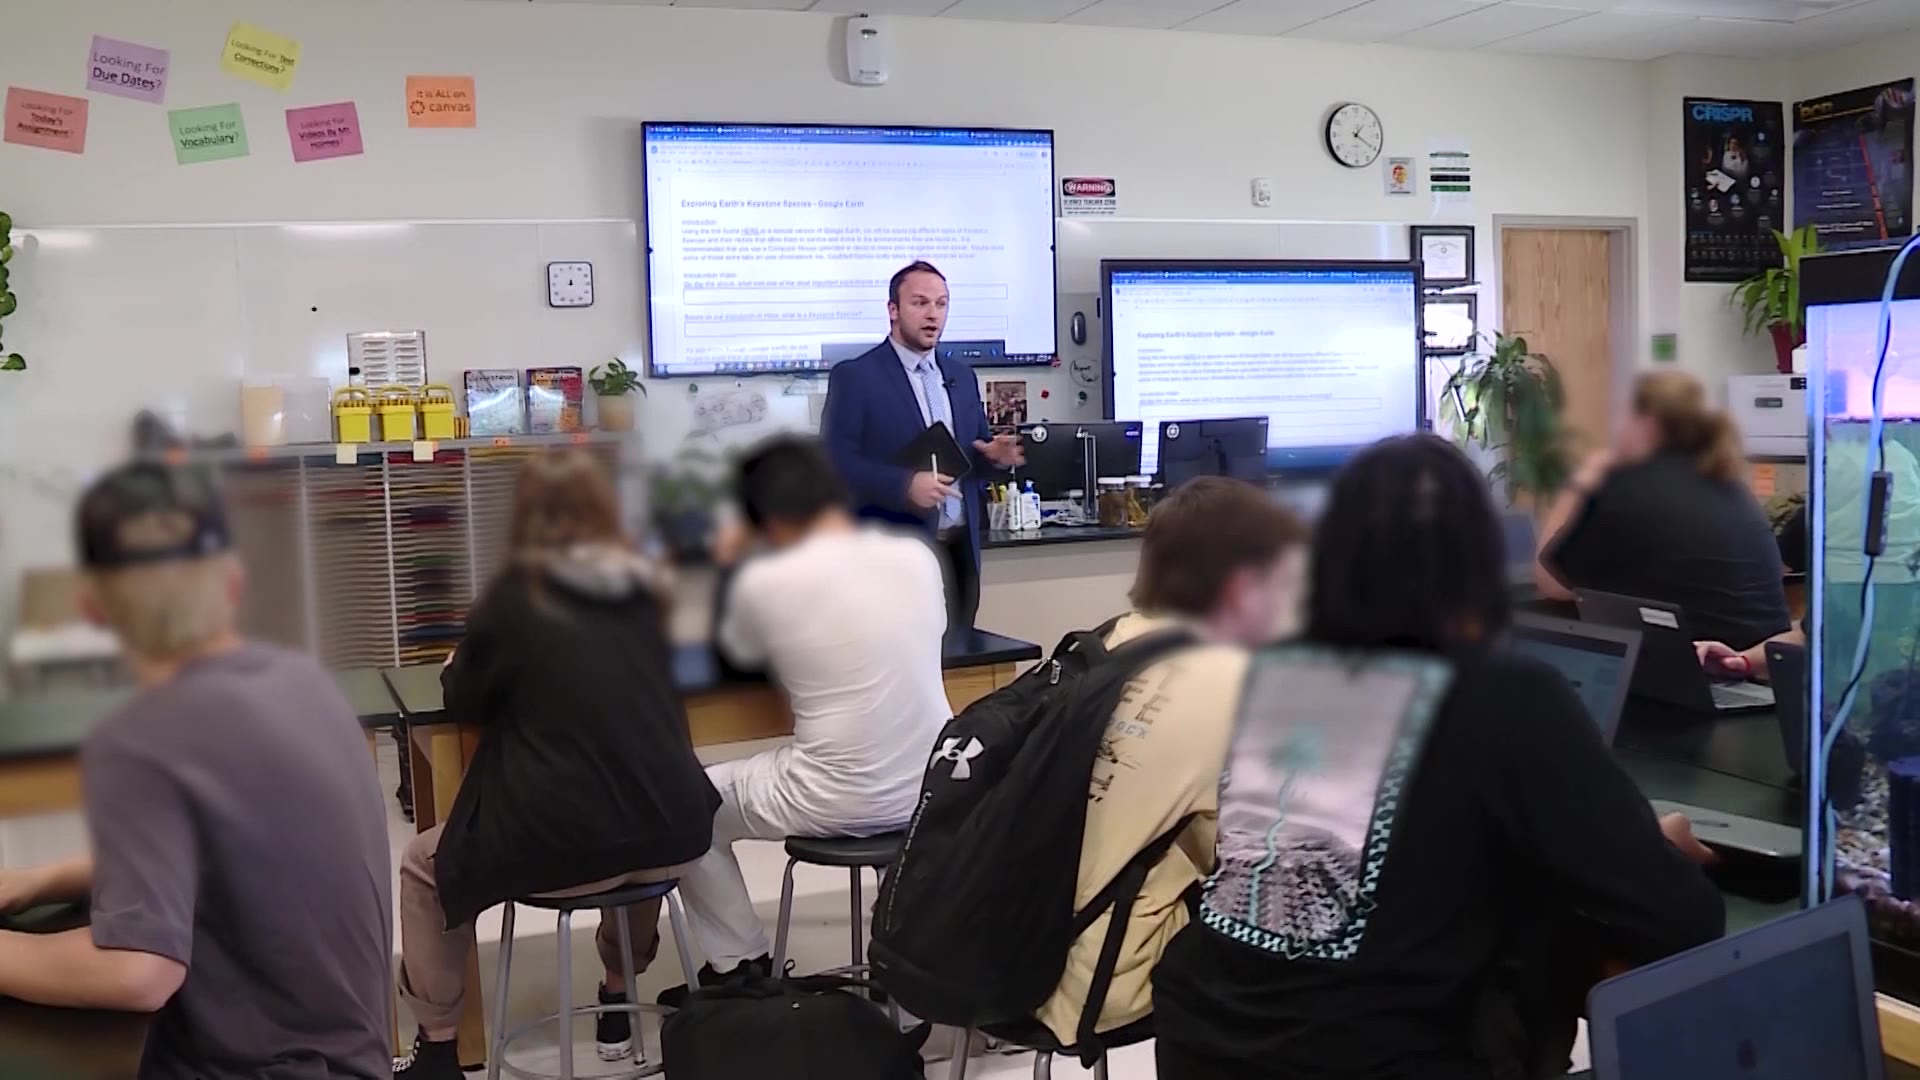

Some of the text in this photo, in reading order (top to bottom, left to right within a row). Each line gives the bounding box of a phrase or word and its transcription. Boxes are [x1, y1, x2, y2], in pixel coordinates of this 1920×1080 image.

[231, 40, 262, 56] Looking
[93, 51, 165, 74] Looking For
[93, 66, 162, 91] Due Dates?
[435, 90, 450, 98] ALL
[429, 103, 471, 112] canvas
[1692, 104, 1752, 122] CRISPR
[180, 121, 235, 136] Looking For
[180, 131, 240, 149] Vocabulary?
[1066, 183, 1112, 192] WARNING
[682, 200, 717, 208] Exploring
[719, 200, 744, 208] Earth's
[747, 200, 780, 208] Keystone
[784, 200, 812, 208] Species
[818, 200, 843, 208] Google
[845, 200, 864, 208] Earth
